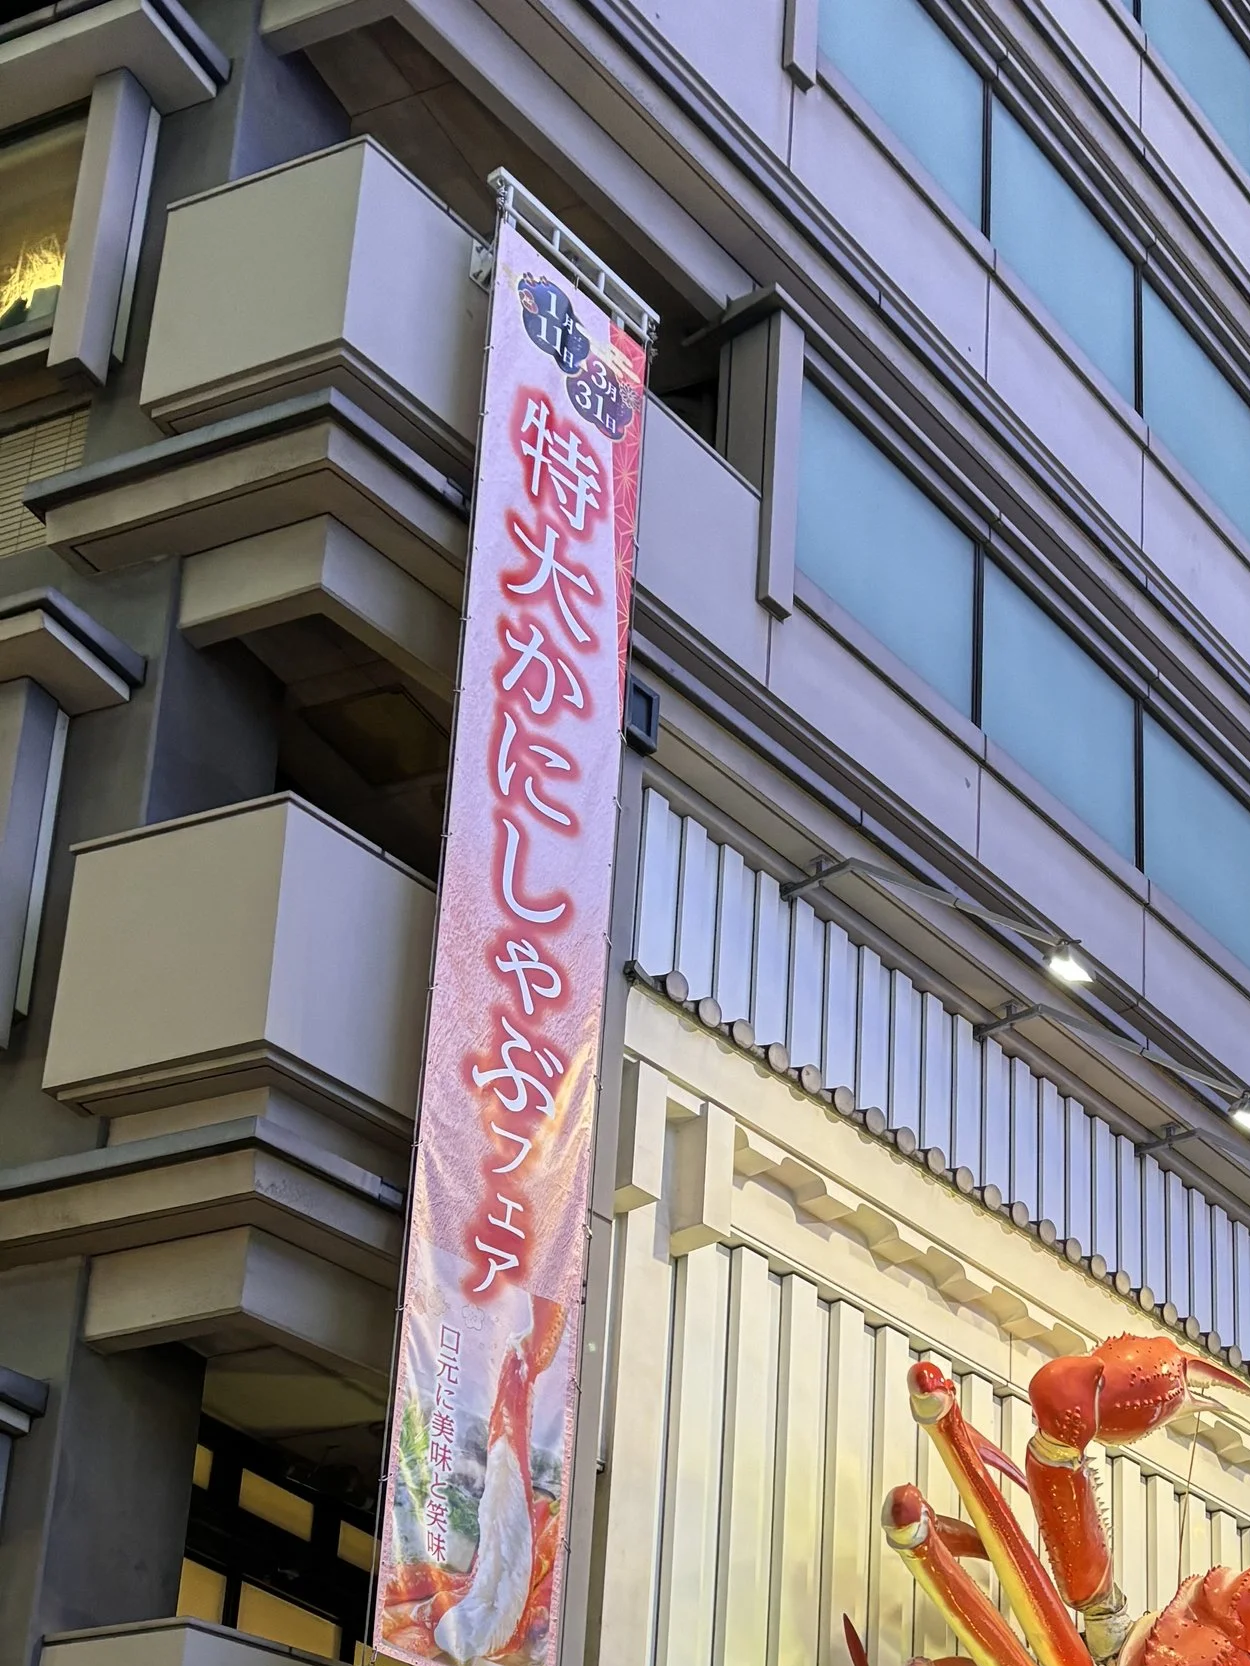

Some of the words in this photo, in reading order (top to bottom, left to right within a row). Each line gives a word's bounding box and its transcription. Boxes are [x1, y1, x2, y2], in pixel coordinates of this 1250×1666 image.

[472, 398, 601, 1293] 特大かにしゃぶフェア
